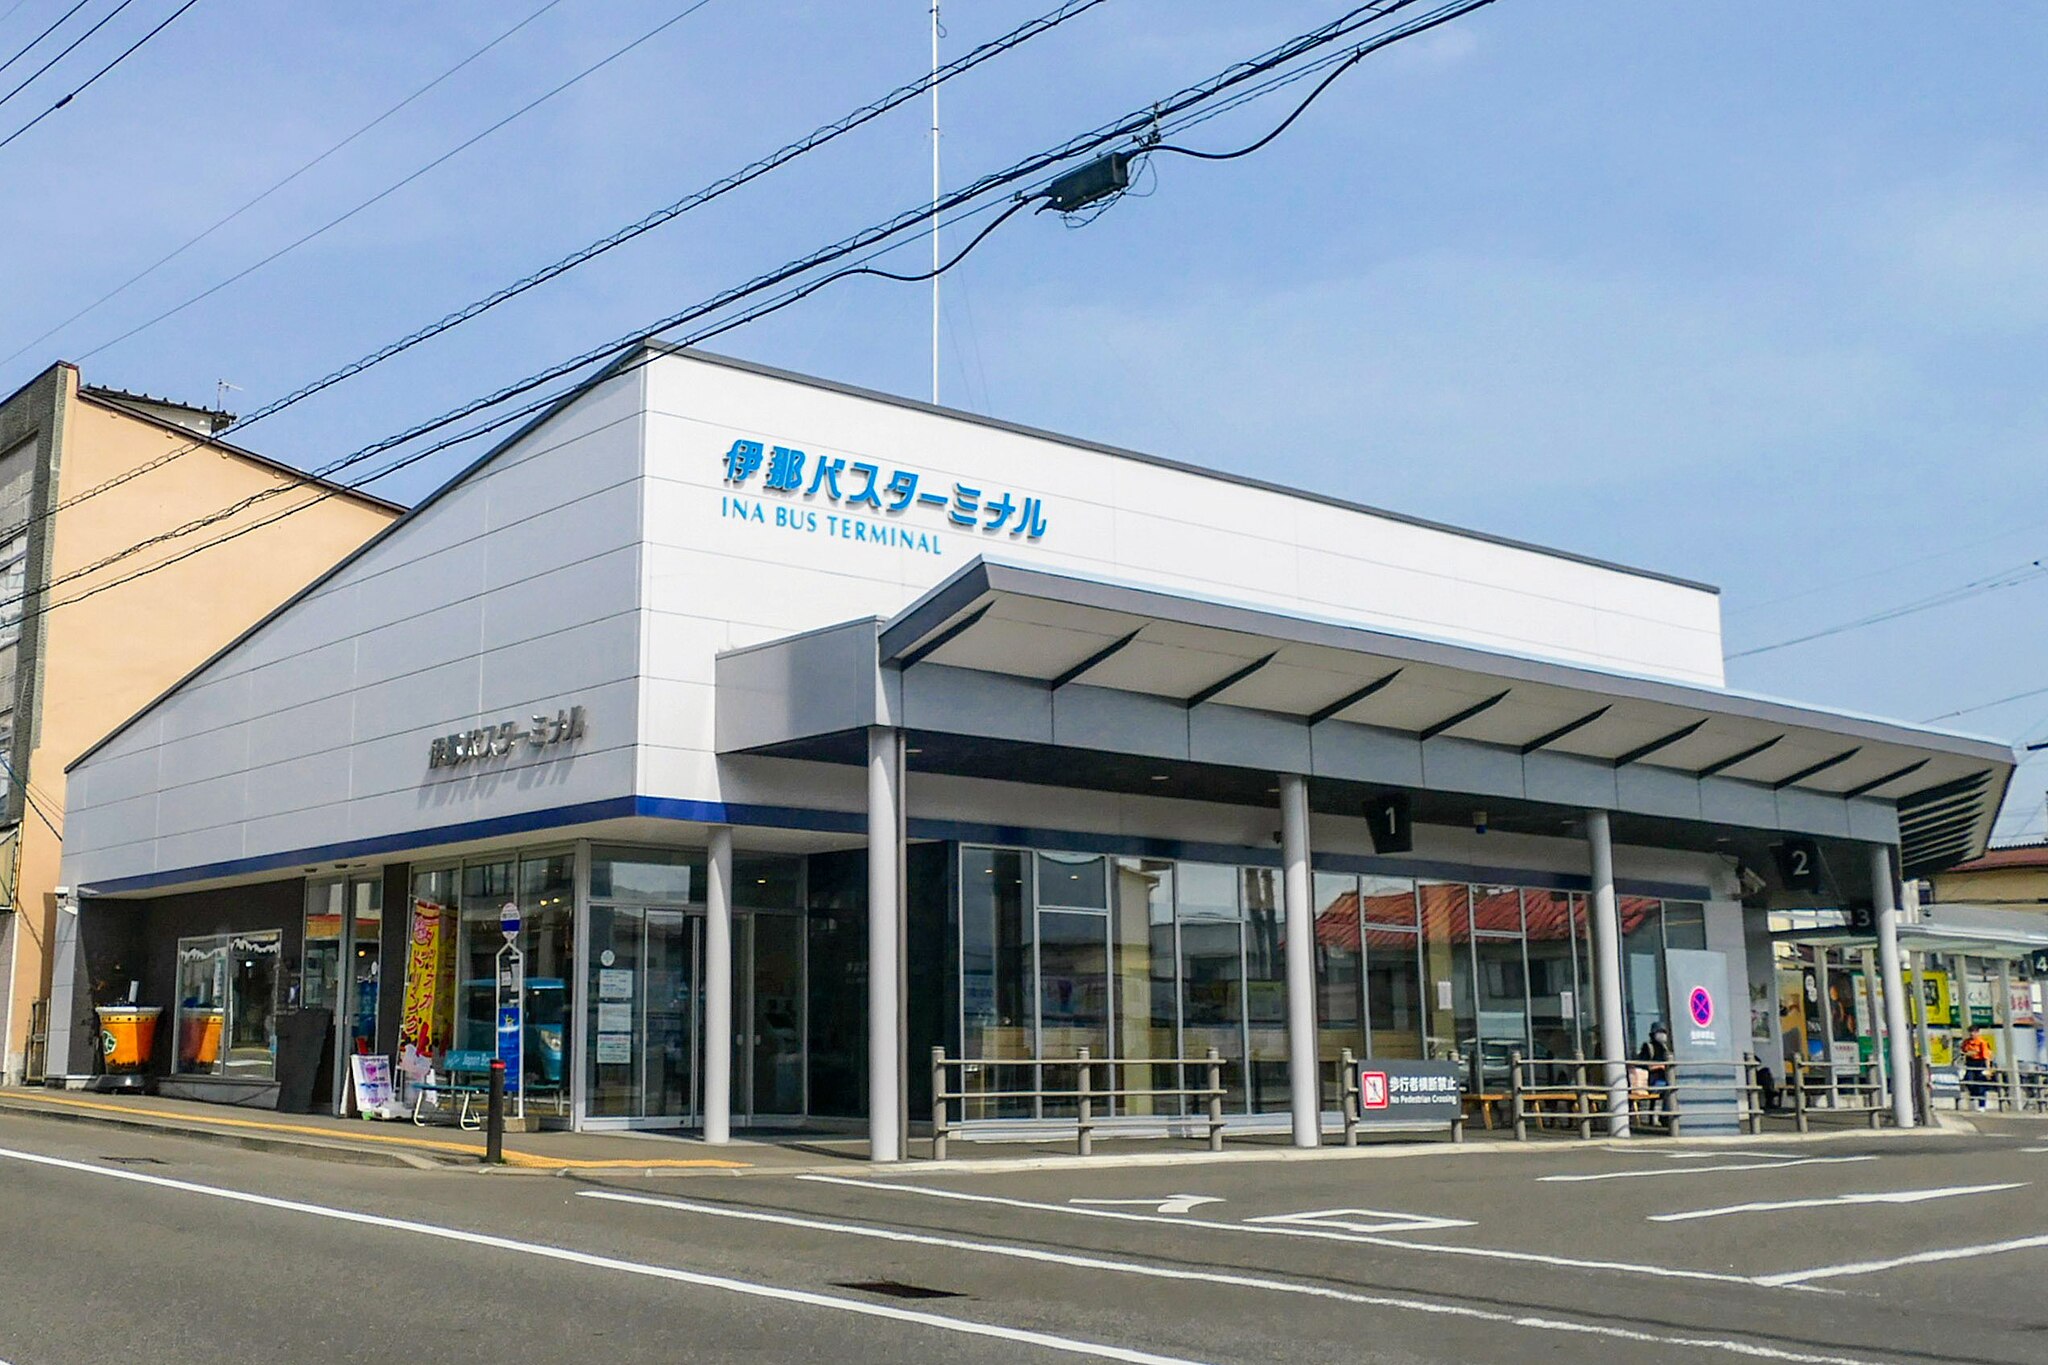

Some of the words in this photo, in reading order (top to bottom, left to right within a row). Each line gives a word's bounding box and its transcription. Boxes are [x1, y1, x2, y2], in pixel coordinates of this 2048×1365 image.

[724, 438, 1047, 538] 伊那バスターミナル
[721, 496, 765, 524] INA
[775, 507, 818, 532] BUS
[826, 516, 943, 555] TERMINAL
[1385, 806, 1396, 835] 1
[1792, 850, 1810, 875] 2
[1856, 908, 1870, 927] 3
[2036, 956, 2047, 972] 4
[1389, 1076, 1457, 1092] 歩行者横断禁止
[1390, 1095, 1399, 1104] No
[1400, 1095, 1431, 1104] Pedestrian
[1432, 1094, 1457, 1105] Crossing
